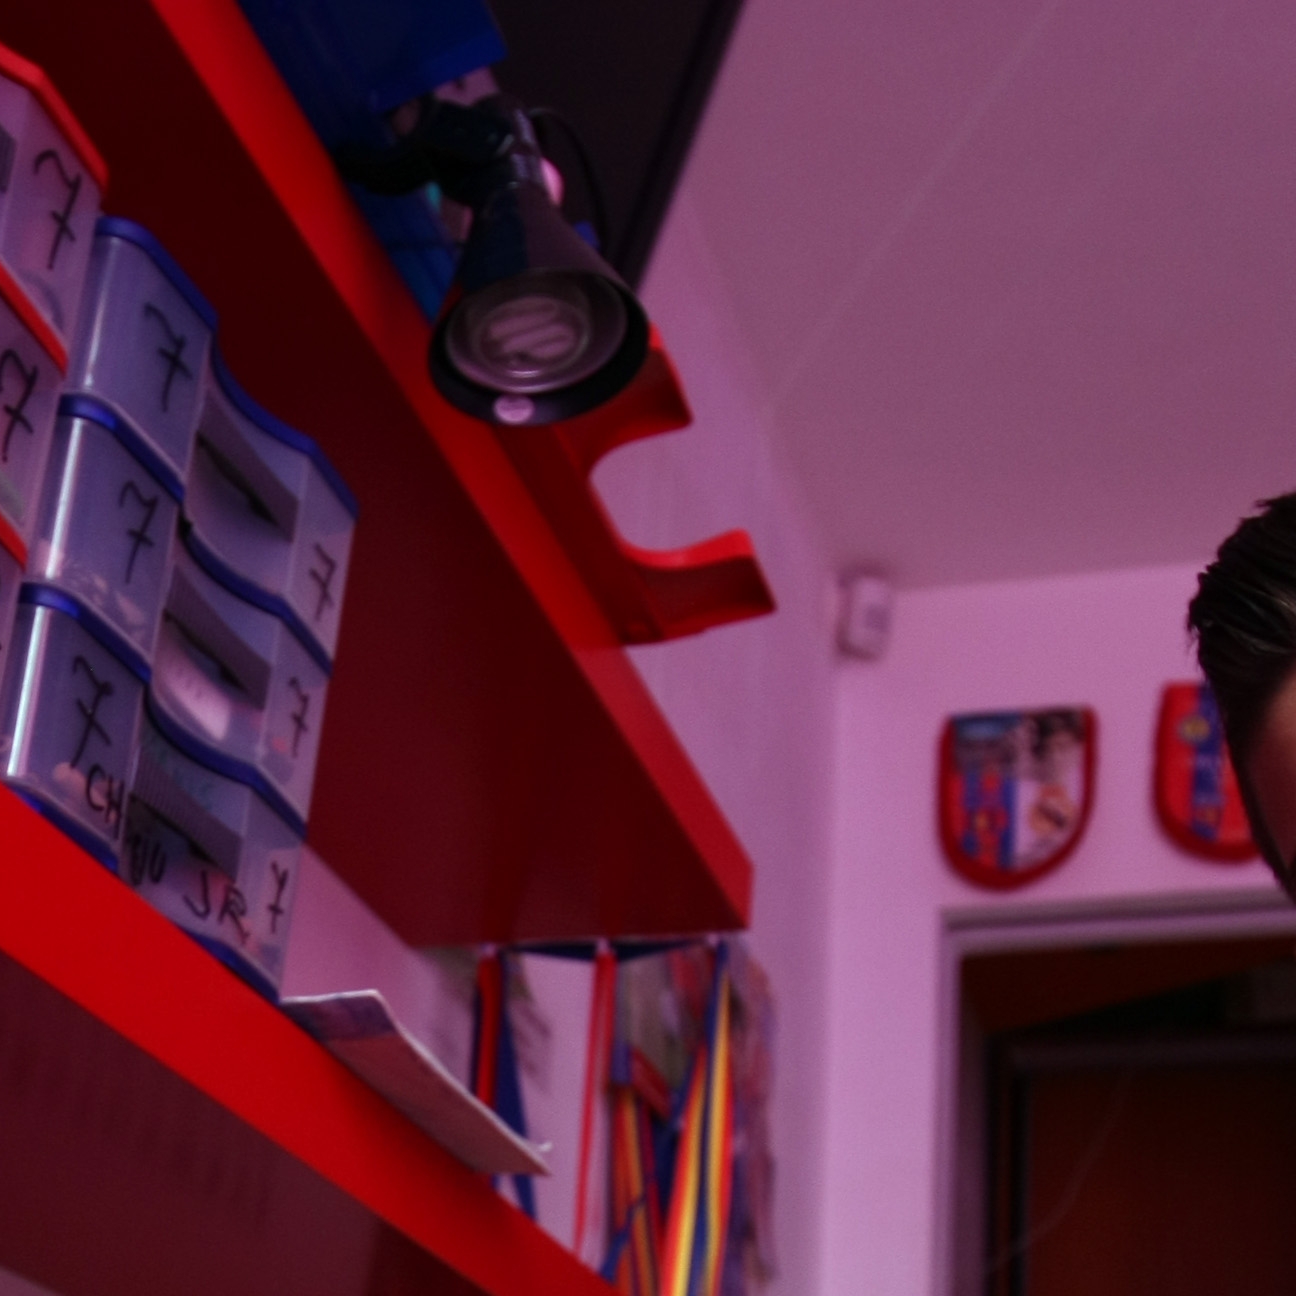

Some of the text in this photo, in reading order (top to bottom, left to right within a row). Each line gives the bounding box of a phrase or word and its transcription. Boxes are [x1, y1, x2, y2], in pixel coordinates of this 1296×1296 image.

[34, 148, 83, 270] 7
[144, 301, 193, 413] 7
[118, 480, 159, 584] 7
[71, 654, 113, 769] 7
[286, 675, 310, 759] 7
